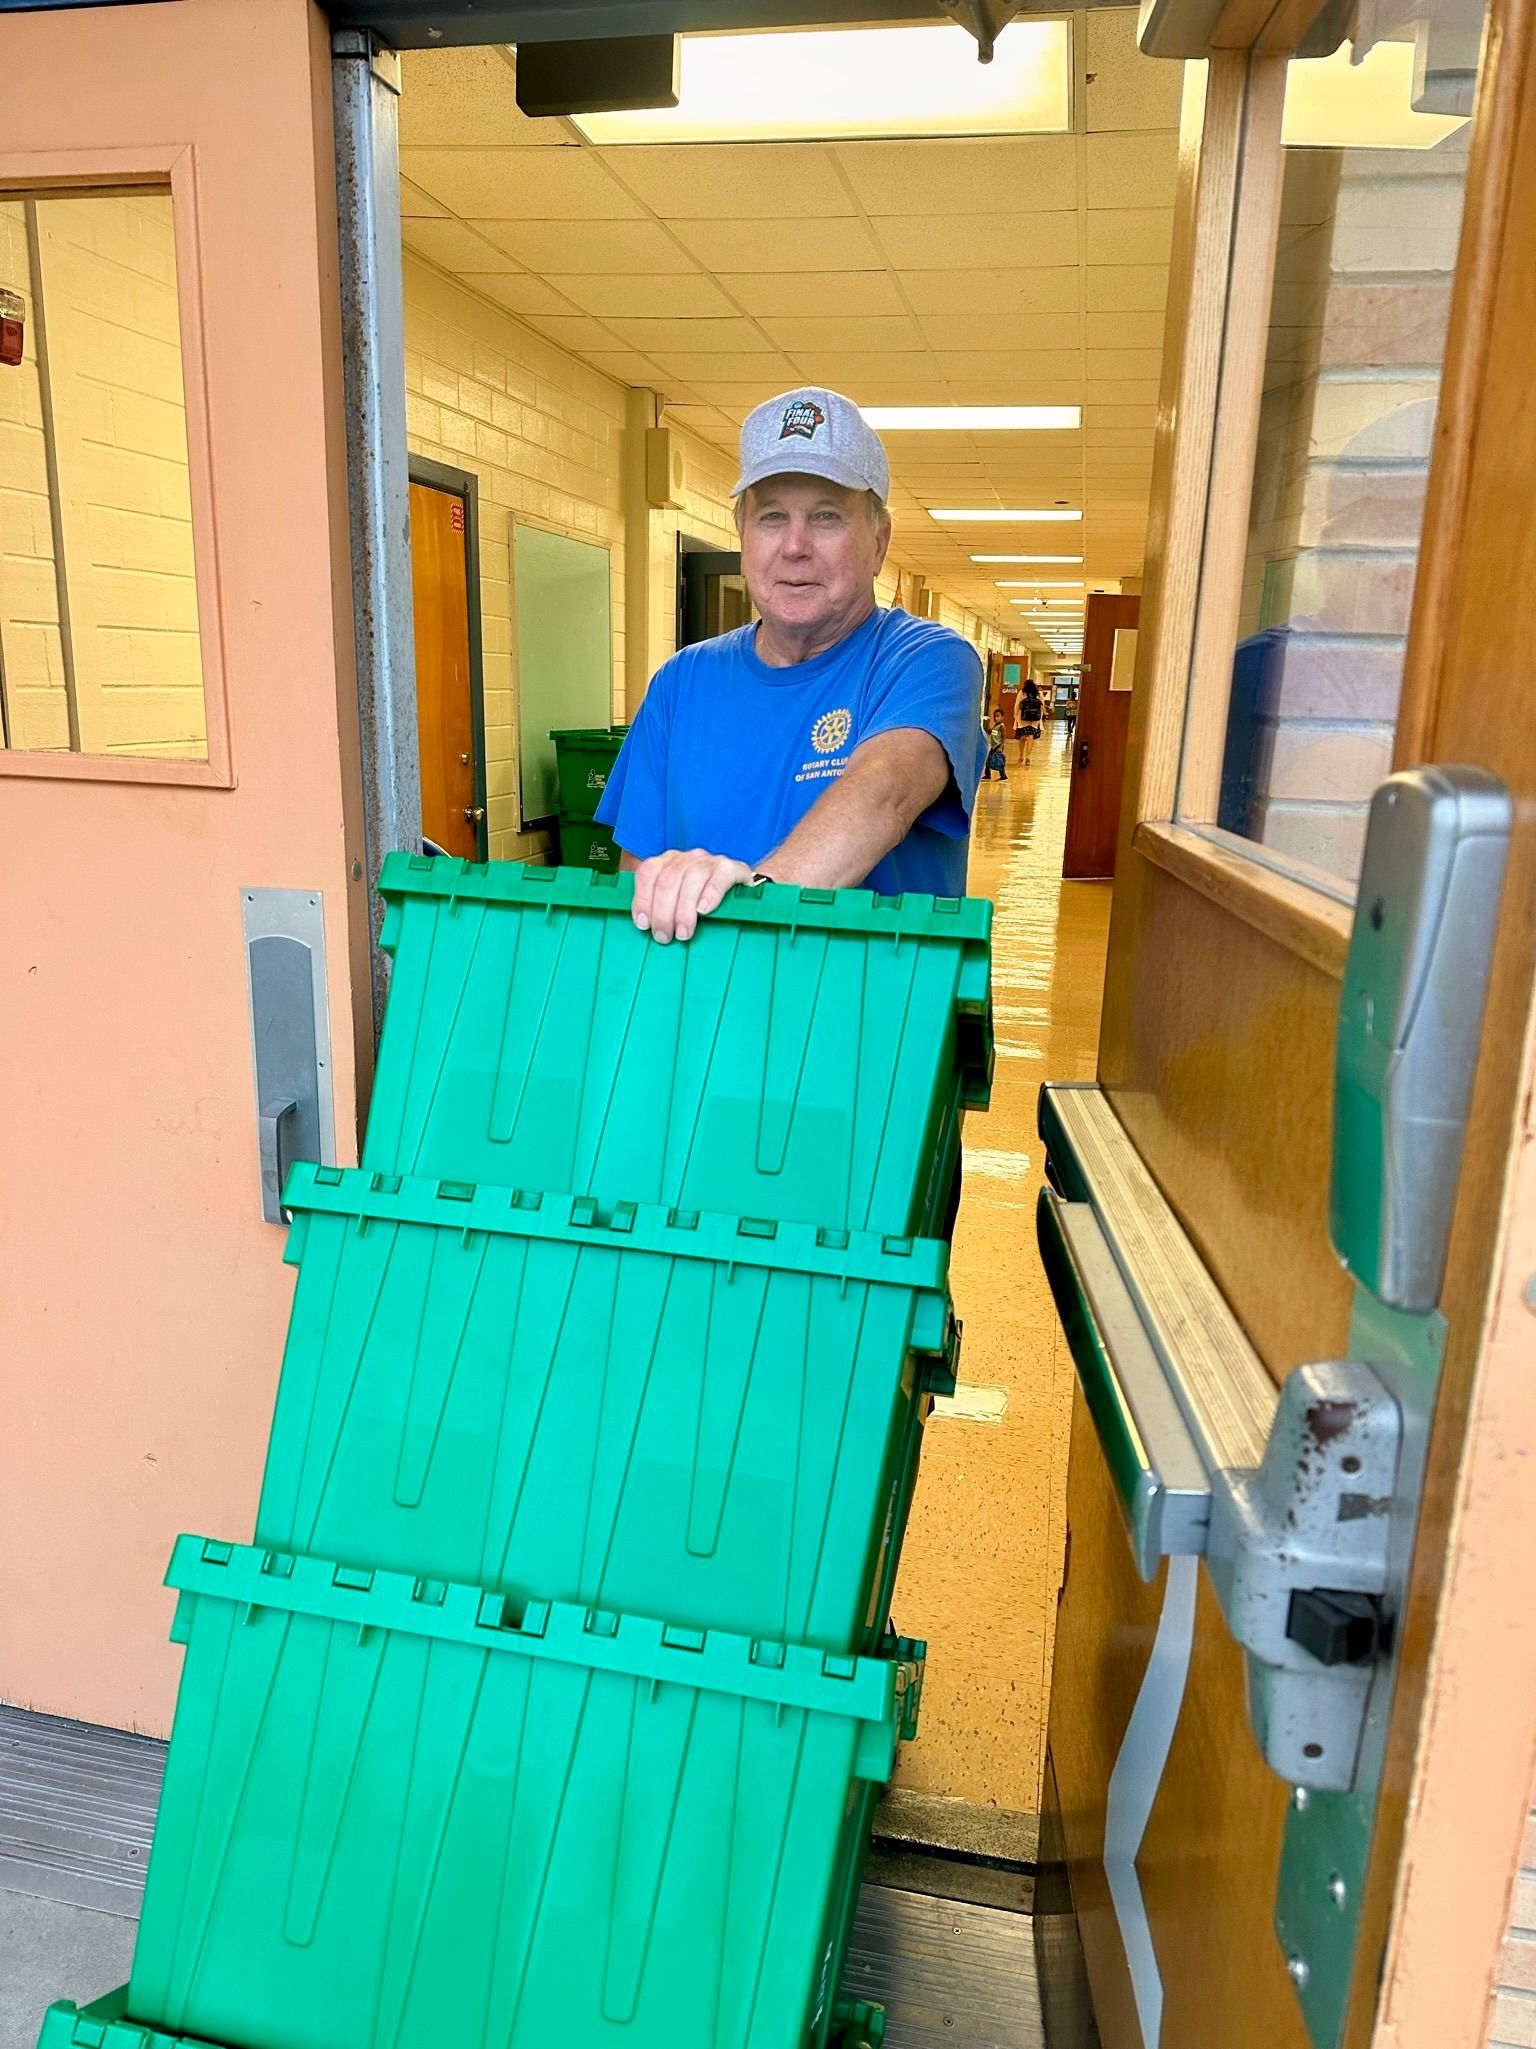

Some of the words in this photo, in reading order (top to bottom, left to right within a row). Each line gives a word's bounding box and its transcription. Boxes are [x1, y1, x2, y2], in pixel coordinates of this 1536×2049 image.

[786, 408, 815, 419] FINAL
[787, 416, 815, 426] FOUR
[802, 759, 829, 771] ROTARY
[795, 774, 805, 782] OF
[806, 771, 820, 780] SAN
